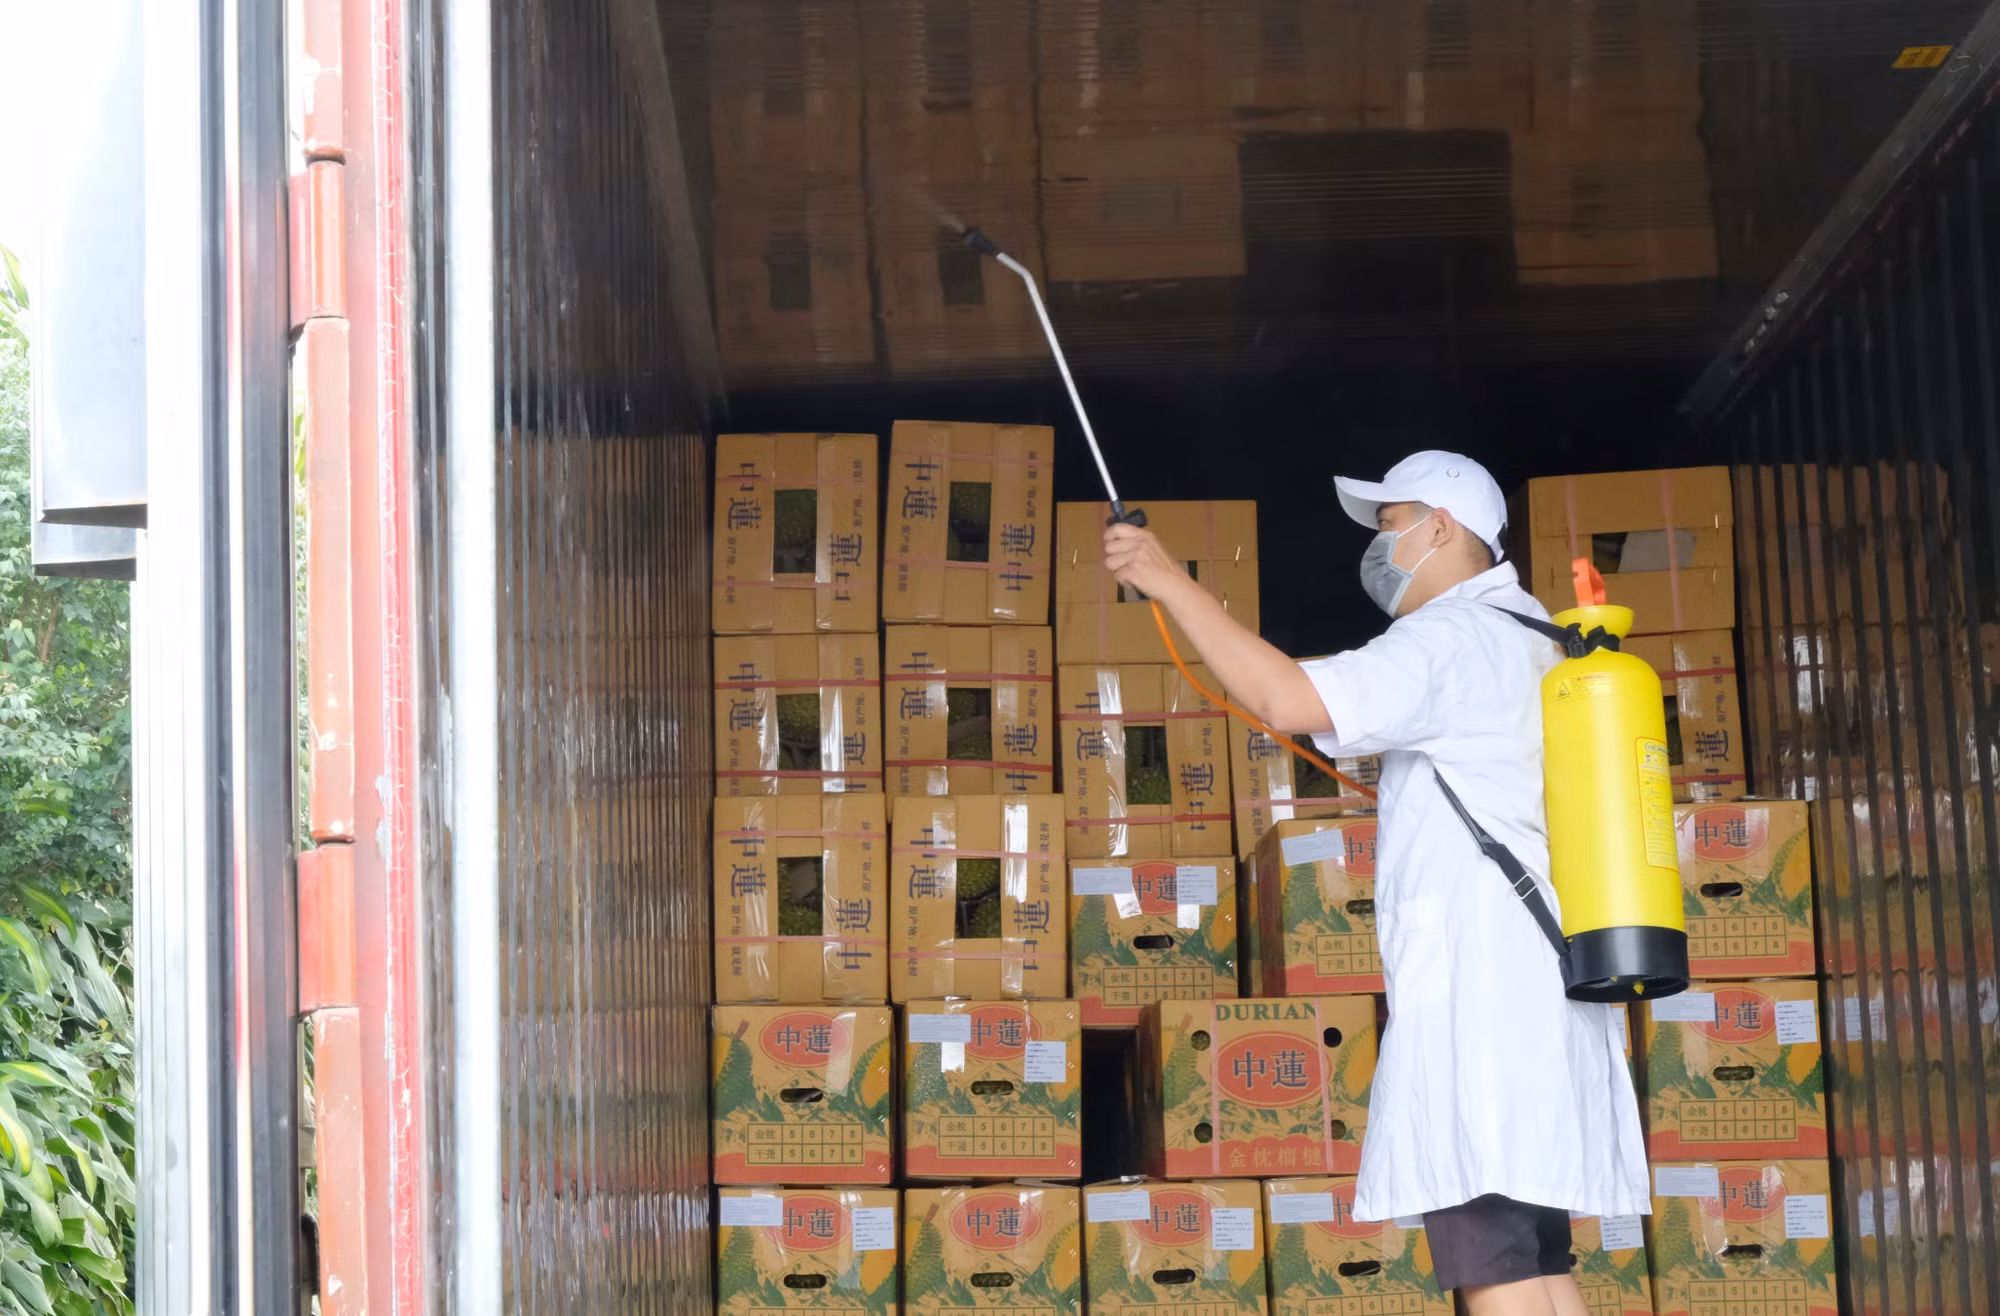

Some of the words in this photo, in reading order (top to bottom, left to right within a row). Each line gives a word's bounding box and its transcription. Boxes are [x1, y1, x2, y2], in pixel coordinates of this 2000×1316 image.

[1215, 1002, 1317, 1021] DURIAN
[776, 1023, 834, 1056] 中蓮
[1233, 1049, 1309, 1089] 中蓮
[783, 1207, 835, 1239] 中蓮
[966, 1207, 1023, 1239] 中蓮
[1146, 1203, 1201, 1234] 中蓮
